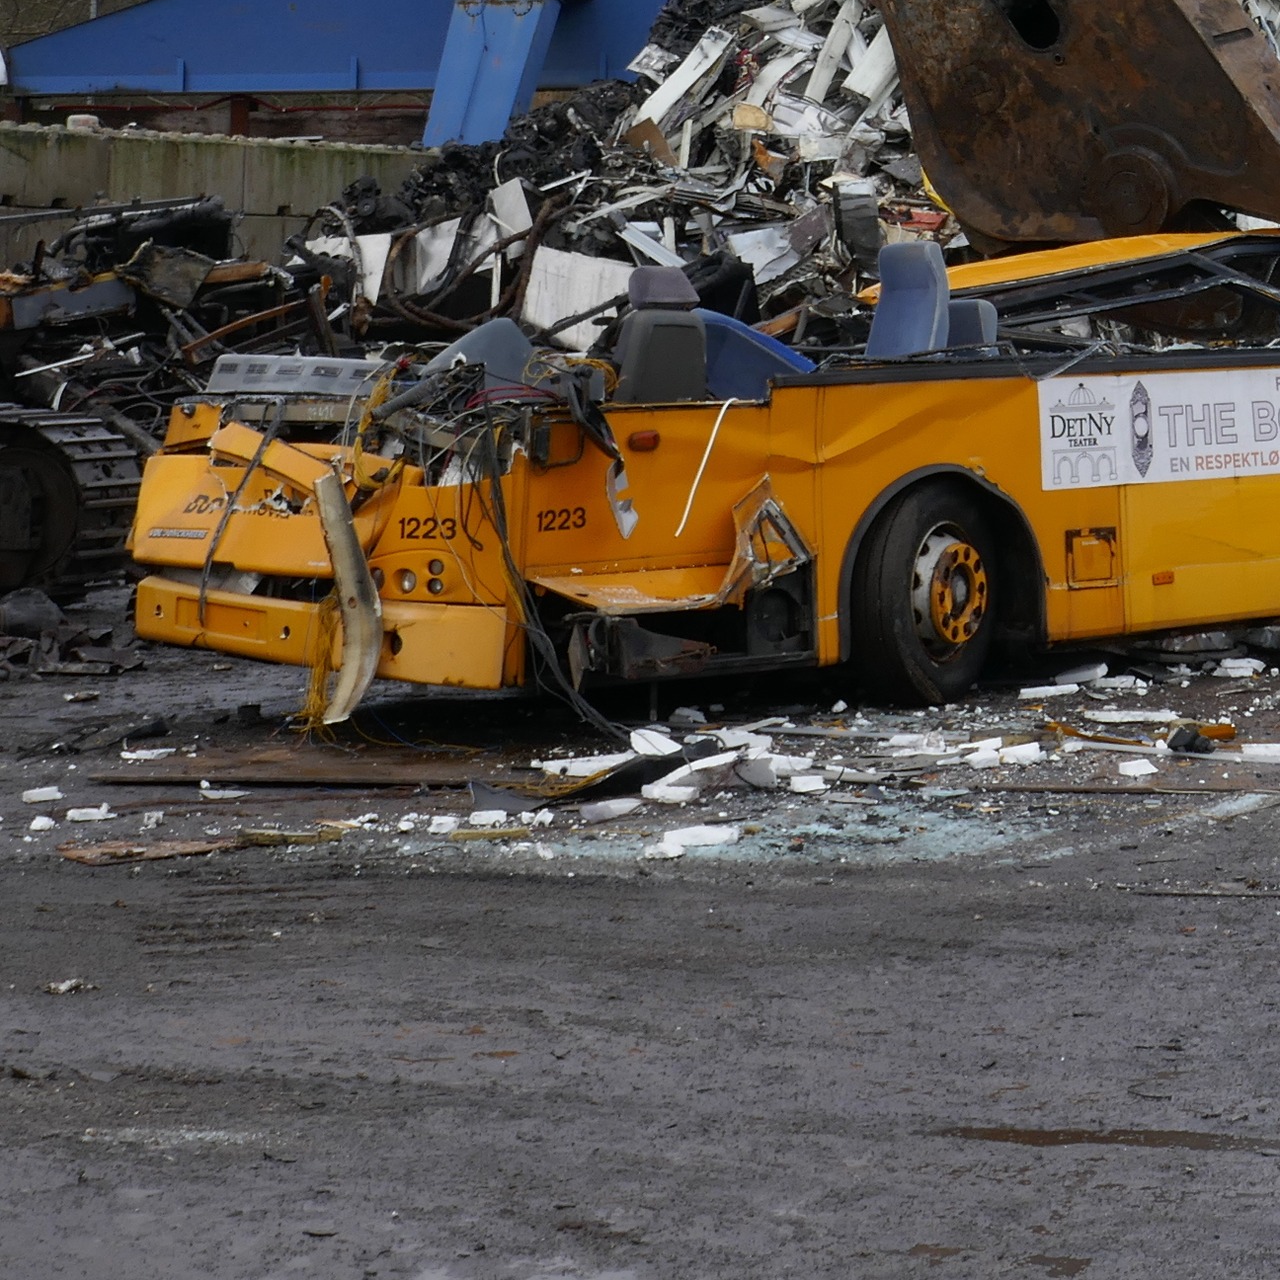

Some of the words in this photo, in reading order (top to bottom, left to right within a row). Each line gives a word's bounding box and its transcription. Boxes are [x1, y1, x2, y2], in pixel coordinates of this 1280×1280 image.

[1158, 402, 1238, 448] THE
[1068, 438, 1098, 448] TEATER
[1170, 457, 1190, 473] EN
[399, 517, 457, 540] 1223
[537, 507, 586, 532] 1223
